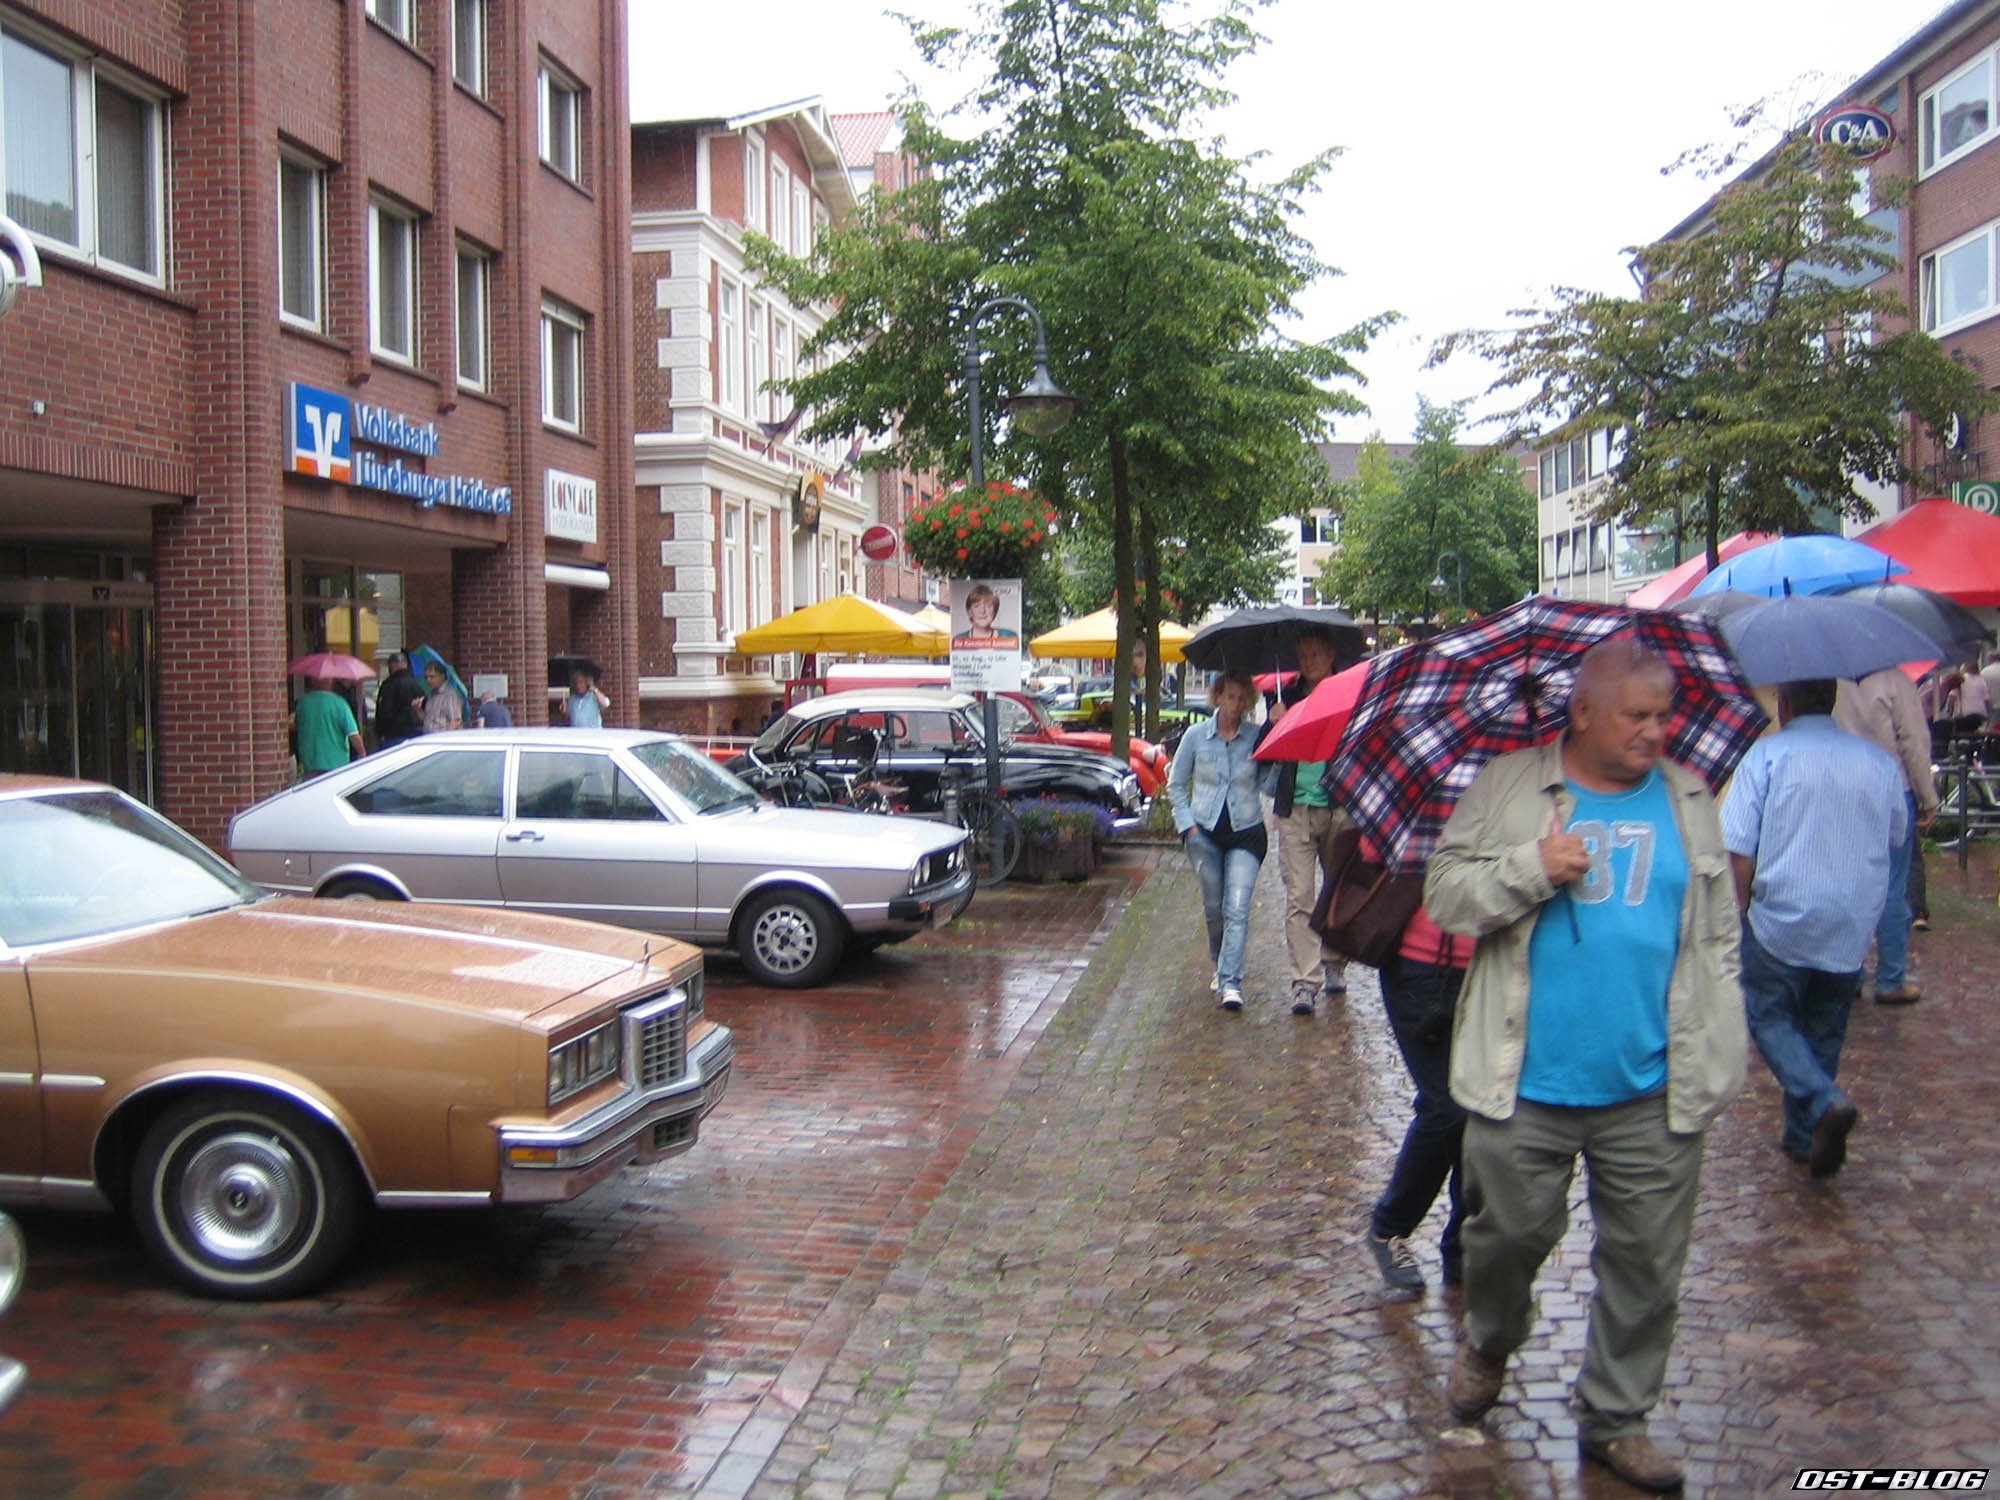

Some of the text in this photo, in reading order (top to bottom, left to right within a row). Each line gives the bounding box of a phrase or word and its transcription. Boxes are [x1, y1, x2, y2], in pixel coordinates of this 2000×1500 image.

[1831, 119, 1880, 149] C&A
[354, 402, 440, 457] Volksbank
[355, 451, 450, 509] Lüneburger
[450, 474, 492, 511] Heide
[1567, 819, 1656, 906] 87
